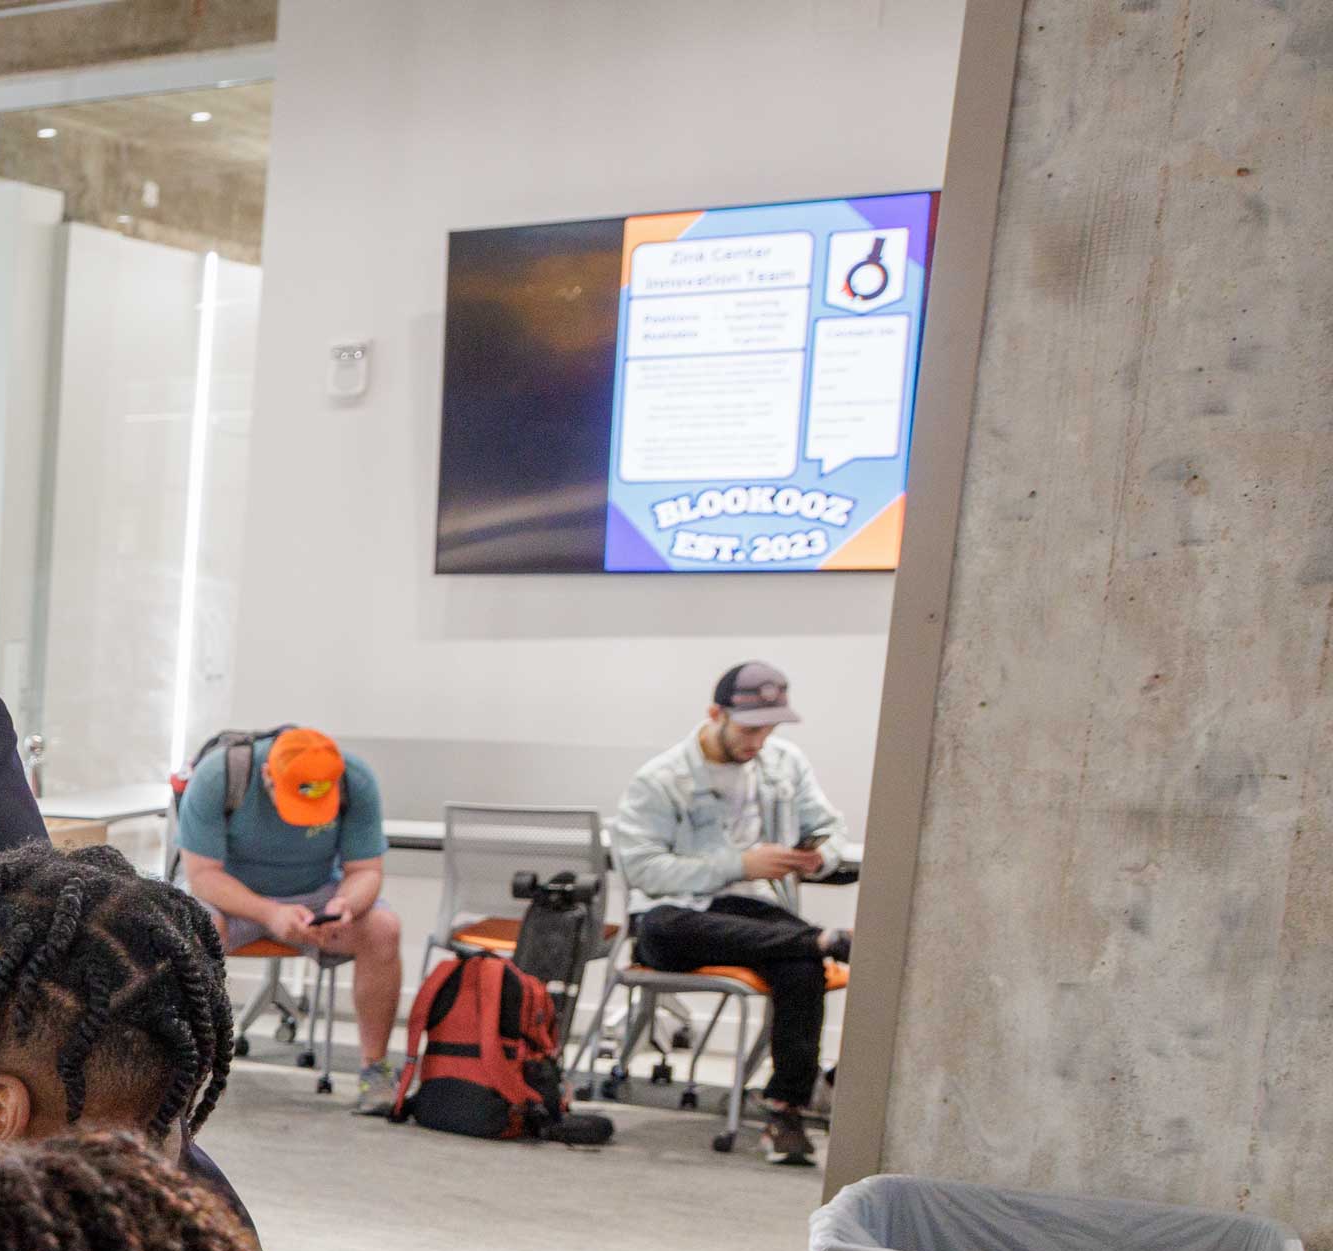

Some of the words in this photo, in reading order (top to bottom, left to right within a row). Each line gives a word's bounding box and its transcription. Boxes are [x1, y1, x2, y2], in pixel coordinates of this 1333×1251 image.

[712, 246, 773, 262] Center
[645, 273, 741, 290] Innovation
[746, 268, 796, 282] Team
[652, 485, 855, 530] BLOOKOOZ
[671, 529, 748, 562] EST.
[748, 528, 829, 563] 2023
